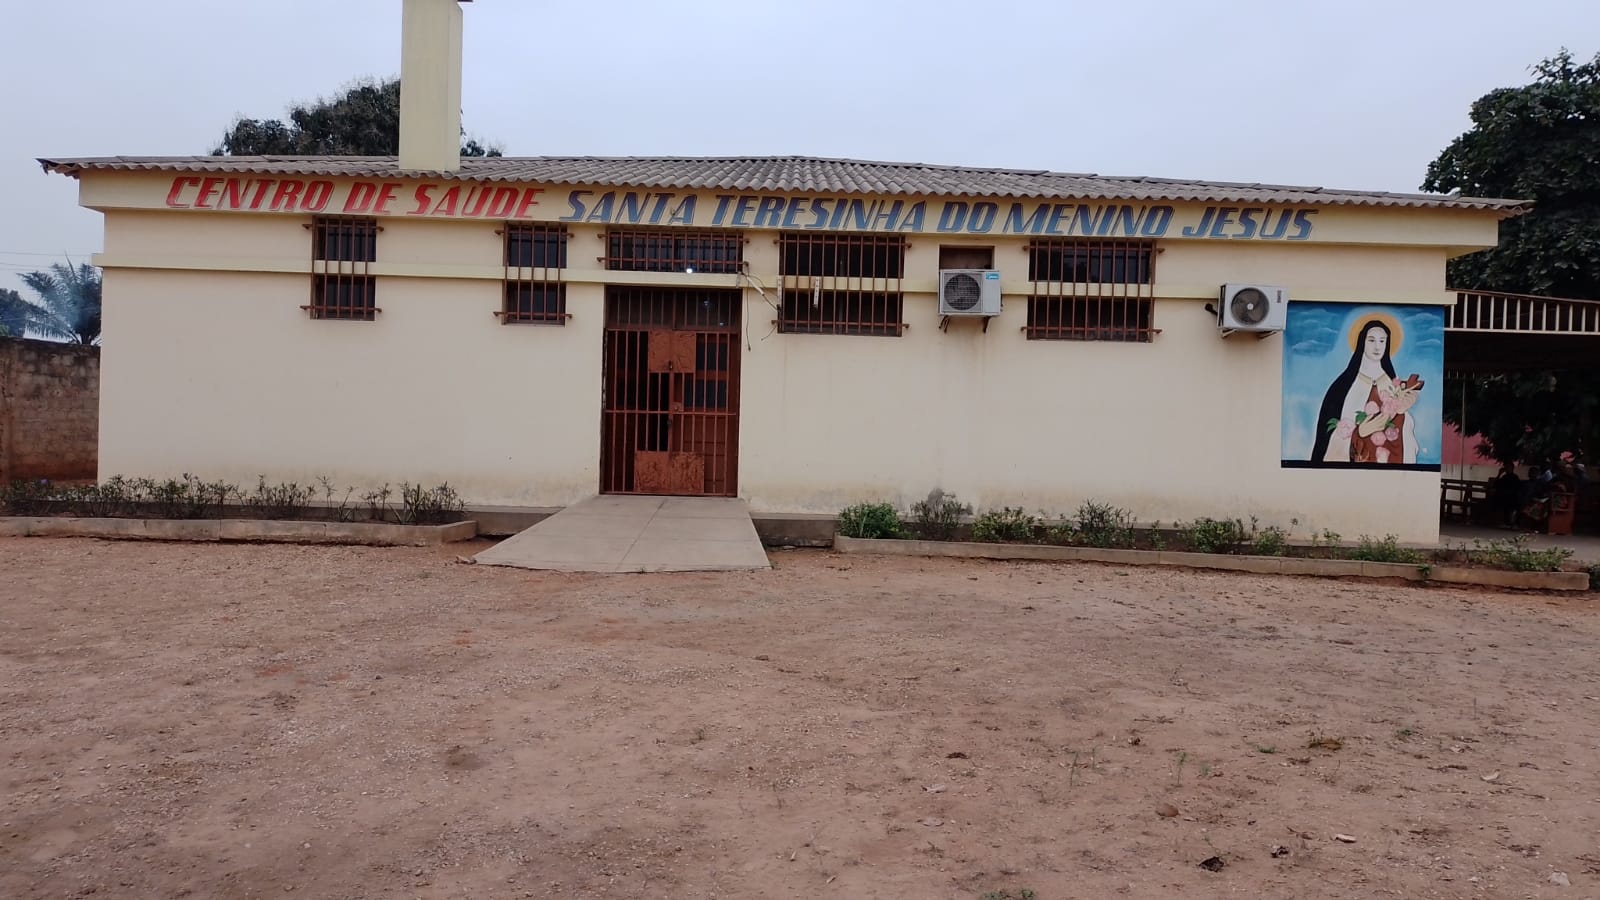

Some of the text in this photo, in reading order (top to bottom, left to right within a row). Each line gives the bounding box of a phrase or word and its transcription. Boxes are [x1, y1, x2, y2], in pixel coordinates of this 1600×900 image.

[166, 176, 1319, 240] CENTRO DE SAÚDE SANTA TERESINHA DO MENINO JESUS
